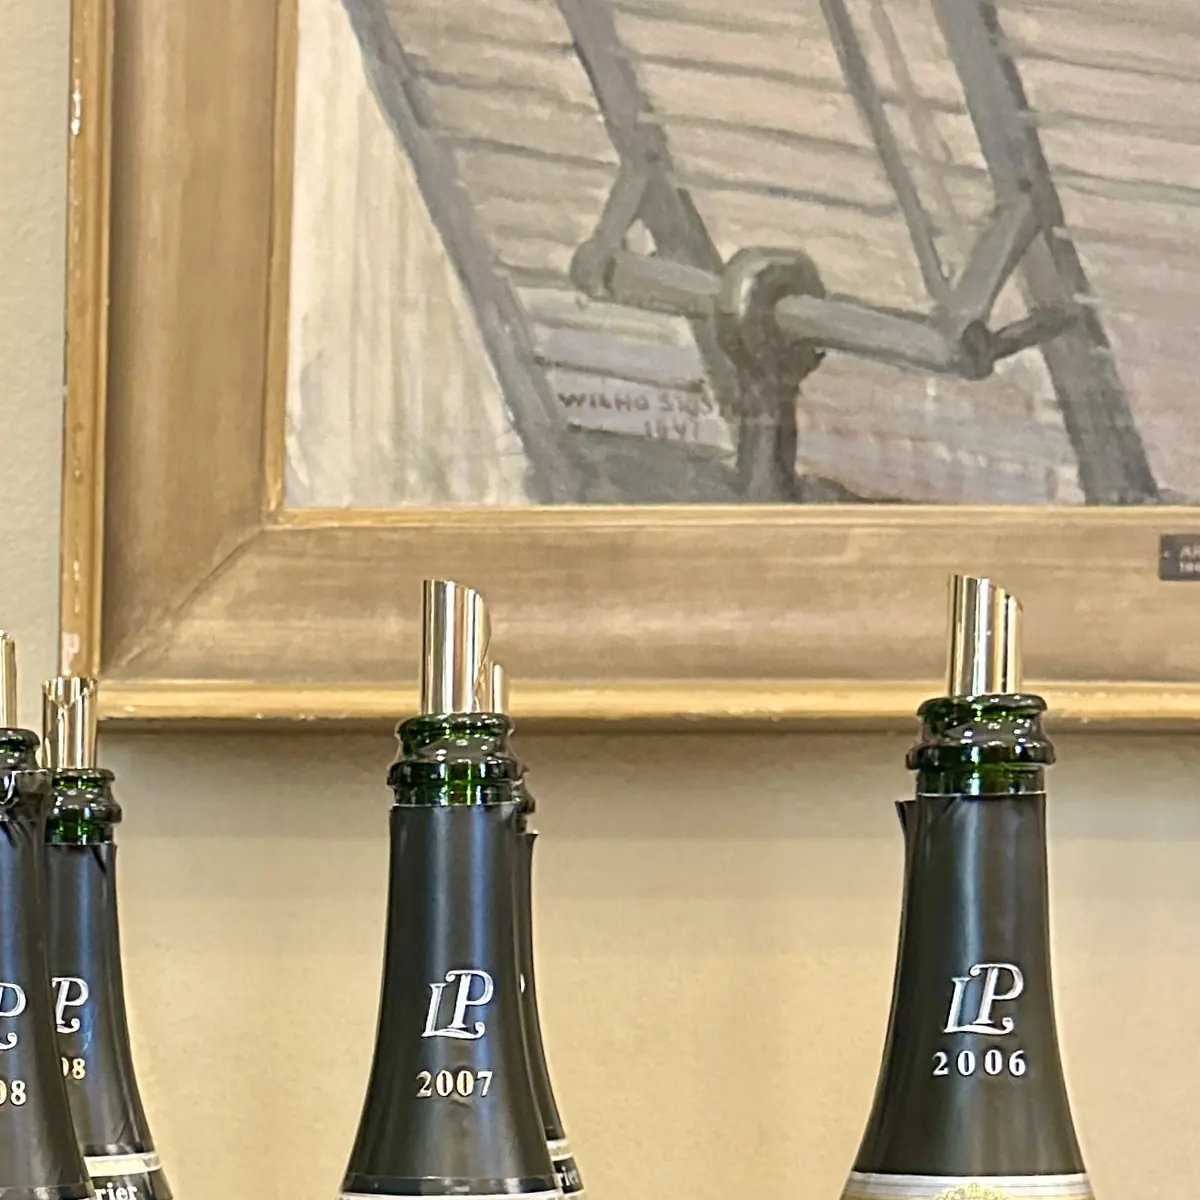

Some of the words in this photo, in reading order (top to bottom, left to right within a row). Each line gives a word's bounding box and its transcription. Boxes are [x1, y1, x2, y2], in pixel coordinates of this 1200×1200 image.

[420, 969, 495, 1040] LP
[943, 962, 1025, 1035] LP
[415, 1068, 494, 1099] 2007
[931, 1049, 1026, 1077] 2006
